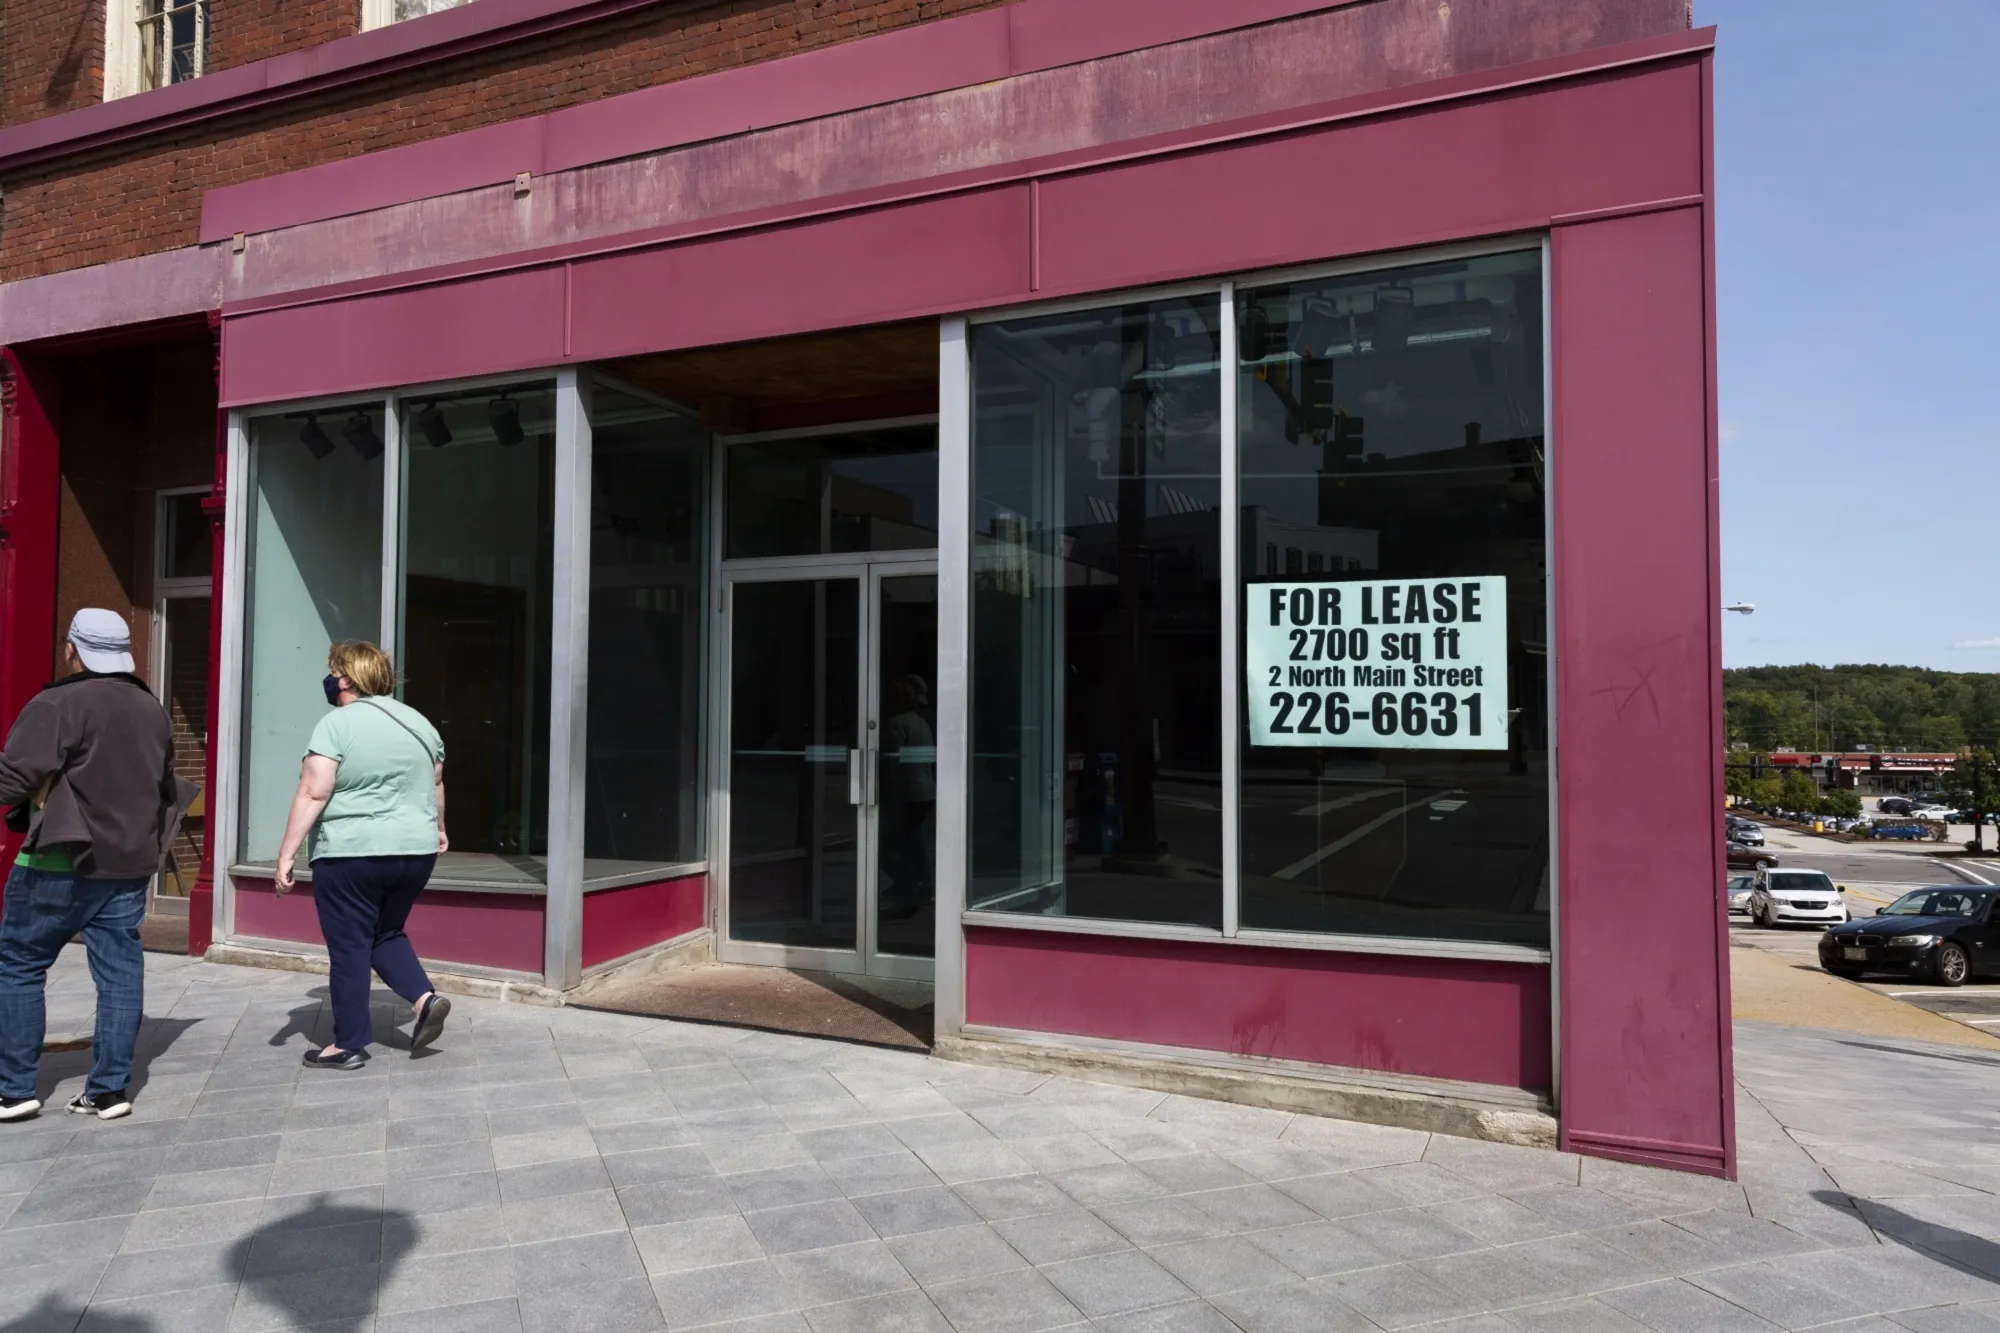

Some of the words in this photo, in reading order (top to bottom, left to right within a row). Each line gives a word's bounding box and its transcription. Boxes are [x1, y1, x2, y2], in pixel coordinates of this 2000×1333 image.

[1269, 587, 1341, 627] FOR
[1361, 582, 1482, 625] LEASE
[1289, 627, 1369, 662] 2700
[1380, 632, 1422, 664] sq
[1433, 626, 1461, 661] ft
[1268, 665, 1282, 687] 2
[1288, 665, 1346, 688] North
[1353, 665, 1406, 688] Main
[1413, 664, 1483, 688] Street
[1269, 691, 1482, 737] 226-6631
